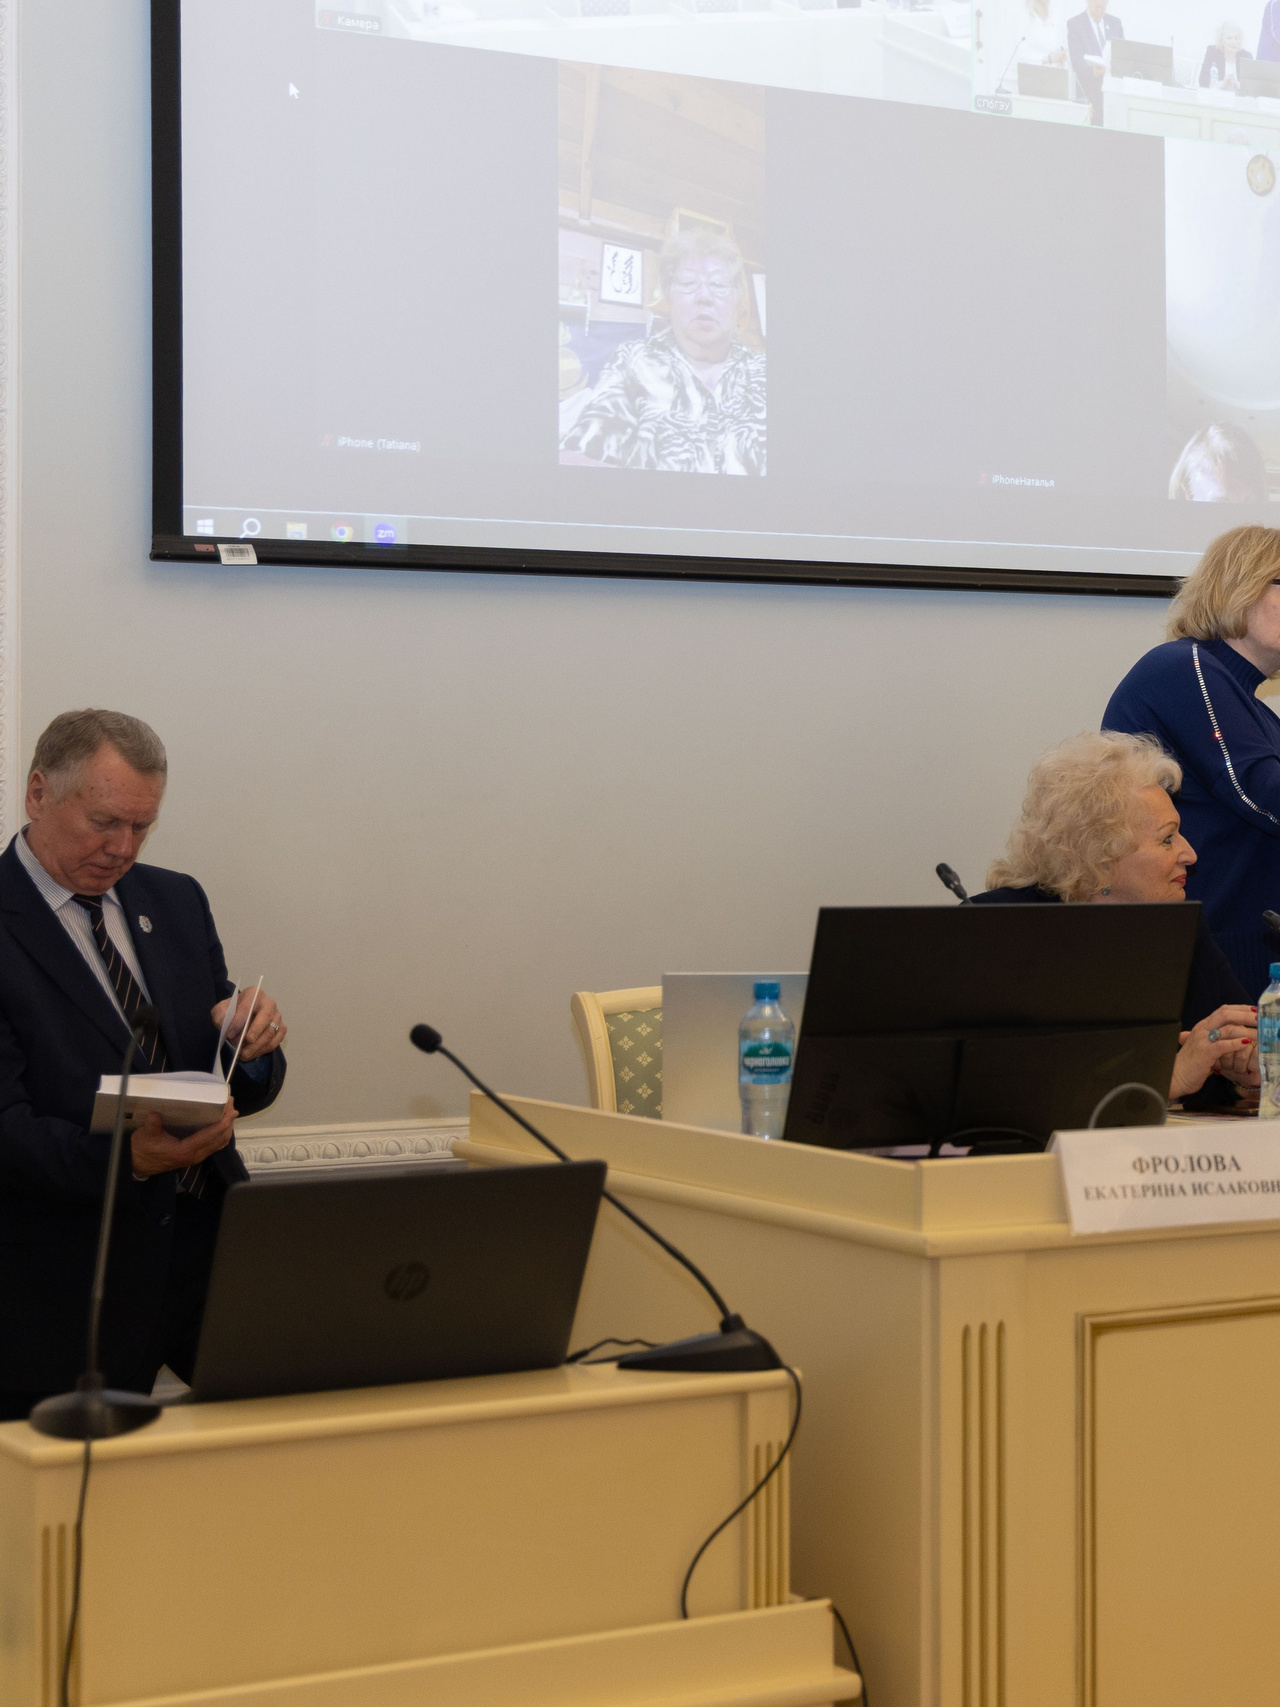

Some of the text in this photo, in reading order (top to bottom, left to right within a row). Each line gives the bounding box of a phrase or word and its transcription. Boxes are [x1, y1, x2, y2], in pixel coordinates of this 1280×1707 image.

[337, 15, 379, 31] Камера
[976, 98, 1010, 111] СПбГЭУ
[338, 436, 420, 453] iPhone (Tatiana)
[992, 474, 1055, 487] iPhoneНаталья
[377, 529, 395, 538] zm
[1132, 1154, 1241, 1175] ФРОЛОВА
[1083, 1182, 1188, 1201] ЕКАТЕРИНА
